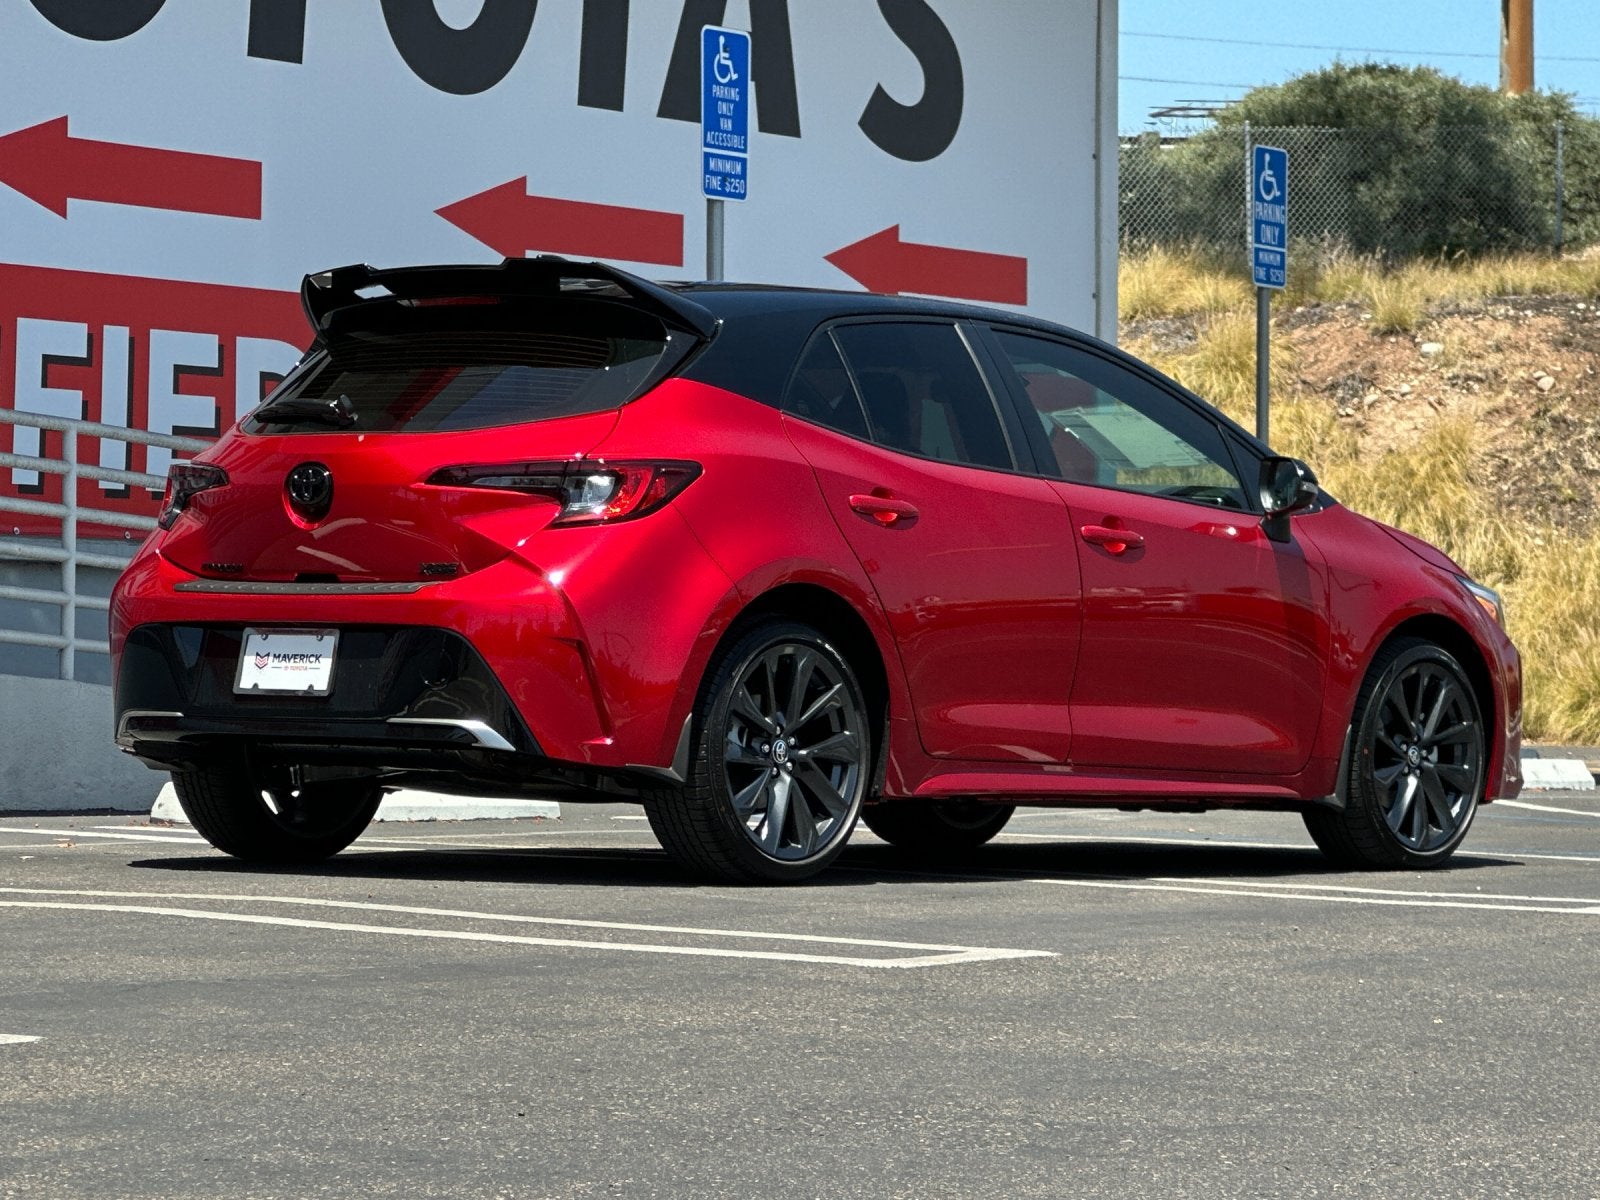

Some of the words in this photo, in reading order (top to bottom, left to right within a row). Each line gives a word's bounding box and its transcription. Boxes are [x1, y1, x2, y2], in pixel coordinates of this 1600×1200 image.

[712, 84, 740, 101] PARKING
[717, 101, 734, 116] ONLY
[719, 117, 732, 131] VAN
[706, 131, 745, 149] ACCESSIBLE
[709, 157, 742, 175] MINIMUM
[705, 174, 722, 191] FINE
[724, 177, 745, 194] $250
[1255, 201, 1285, 225] PARKING
[1260, 223, 1280, 245] ONLY
[271, 653, 322, 664] MAVERICK
